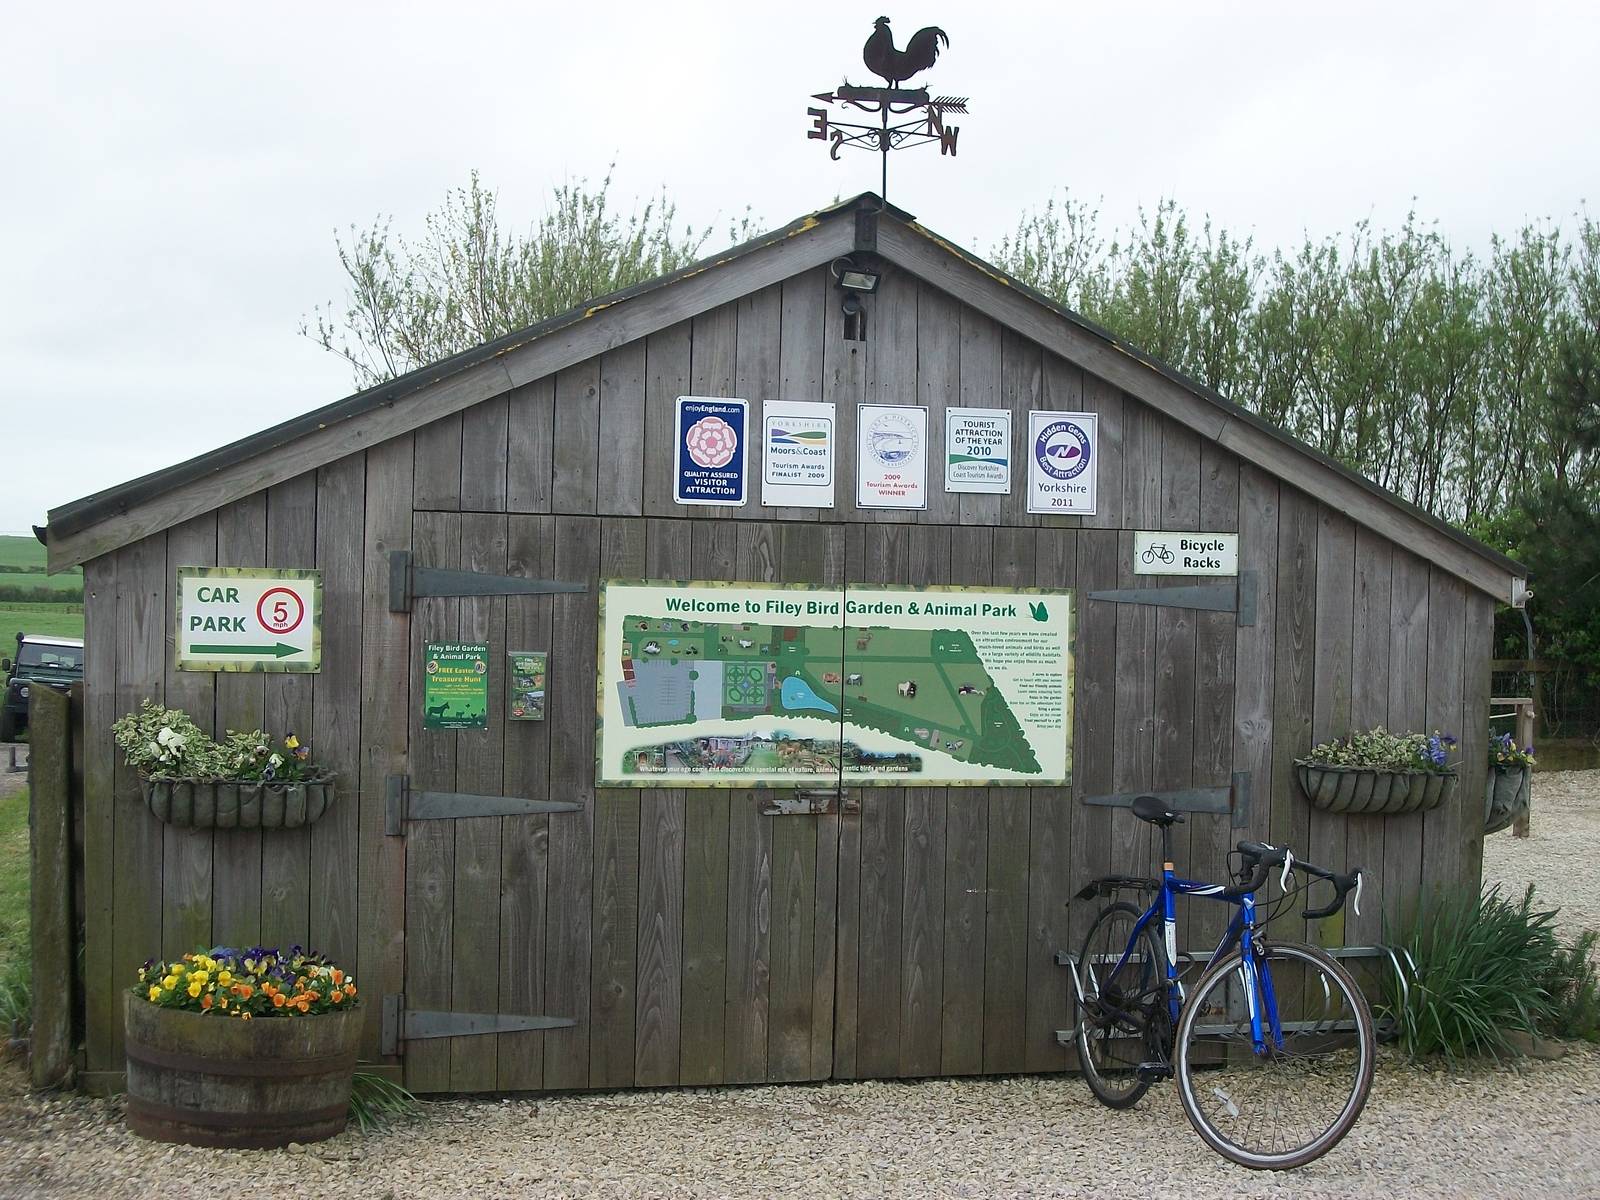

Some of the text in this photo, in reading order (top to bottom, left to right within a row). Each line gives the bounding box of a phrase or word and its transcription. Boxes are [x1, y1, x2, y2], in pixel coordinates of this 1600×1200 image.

[940, 126, 959, 156] W
[685, 404, 740, 414] enjoyEngland.com
[964, 420, 995, 428] TOURIST
[956, 428, 1002, 437] ATTRACTION
[1040, 424, 1086, 444] Hidden Gems
[770, 446, 826, 456] Moors&Coast
[966, 446, 992, 456] 2010
[1040, 456, 1088, 478] Best Attraction
[686, 486, 736, 494] ATTRACTION
[1038, 482, 1087, 494] Yorkshire
[1052, 498, 1073, 506] 2011
[1180, 540, 1224, 554] Bicycle
[1184, 557, 1220, 568] Racks
[197, 587, 240, 604] CAR
[273, 602, 288, 622] 5
[666, 598, 1016, 618] Welcome to Filey Bird Garden & Animal Park
[190, 616, 246, 632] PARK
